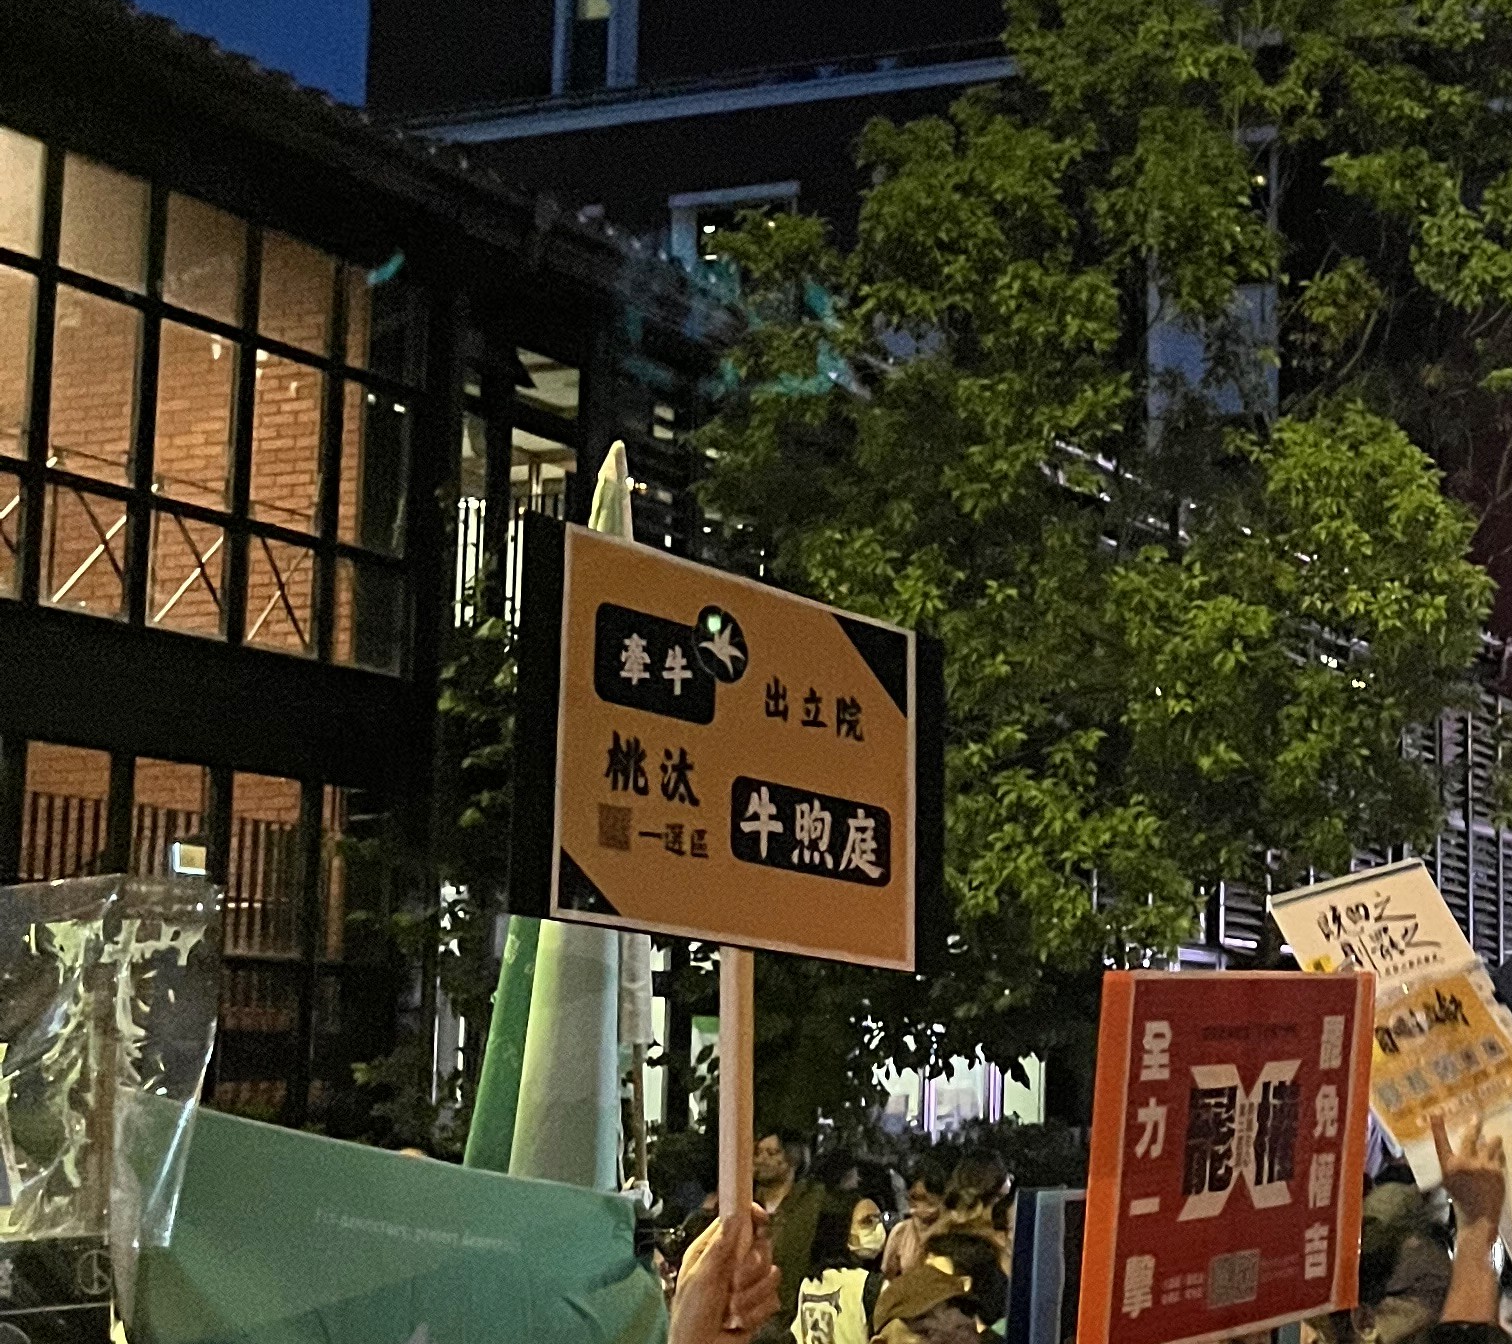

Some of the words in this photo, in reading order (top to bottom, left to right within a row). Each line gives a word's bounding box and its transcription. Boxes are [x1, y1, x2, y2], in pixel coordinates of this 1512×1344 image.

[619, 632, 693, 696] 牽牛
[764, 676, 865, 742] 出立院
[604, 730, 700, 807] 桃汰
[739, 785, 886, 880] 牛煦庭
